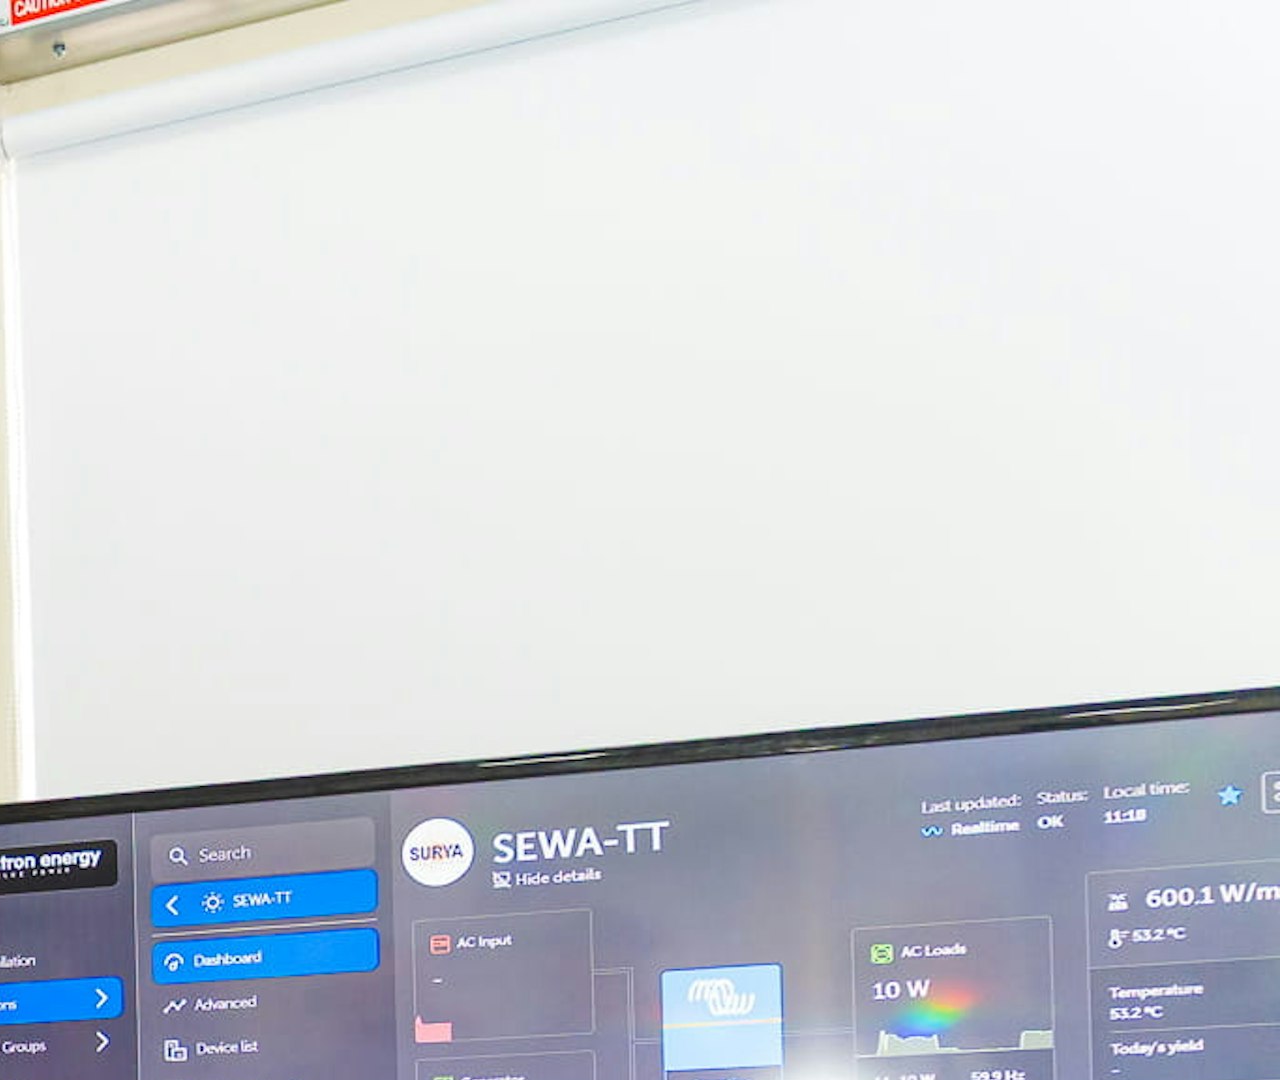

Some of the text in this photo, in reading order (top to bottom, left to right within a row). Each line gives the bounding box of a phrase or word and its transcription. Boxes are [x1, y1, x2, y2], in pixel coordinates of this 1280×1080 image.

[1036, 789, 1089, 806] Status:
[1103, 781, 1190, 800] Local time:
[921, 793, 1023, 815] Last updated:
[951, 819, 1020, 837] Realtime
[1037, 815, 1064, 829] OK
[492, 820, 671, 864] SEWA-TT
[39, 850, 102, 869] energy
[199, 846, 252, 863] Search
[409, 843, 463, 861] SURYA
[515, 868, 602, 886] Hide details
[232, 890, 292, 908] SEWA-TT
[1145, 886, 1215, 908] 600.1
[1166, 926, 1188, 940] °C
[456, 934, 512, 950] AC Input
[900, 942, 967, 958] AC Loads
[193, 951, 263, 968] Dashboard
[872, 979, 931, 1000] 10 W
[1108, 984, 1205, 1000] Temperature
[194, 995, 258, 1012] Advanced
[1144, 1005, 1164, 1018] °C
[2, 1040, 47, 1056] Groups
[195, 1039, 259, 1056] Device list
[1110, 1038, 1205, 1057] Today's yield
